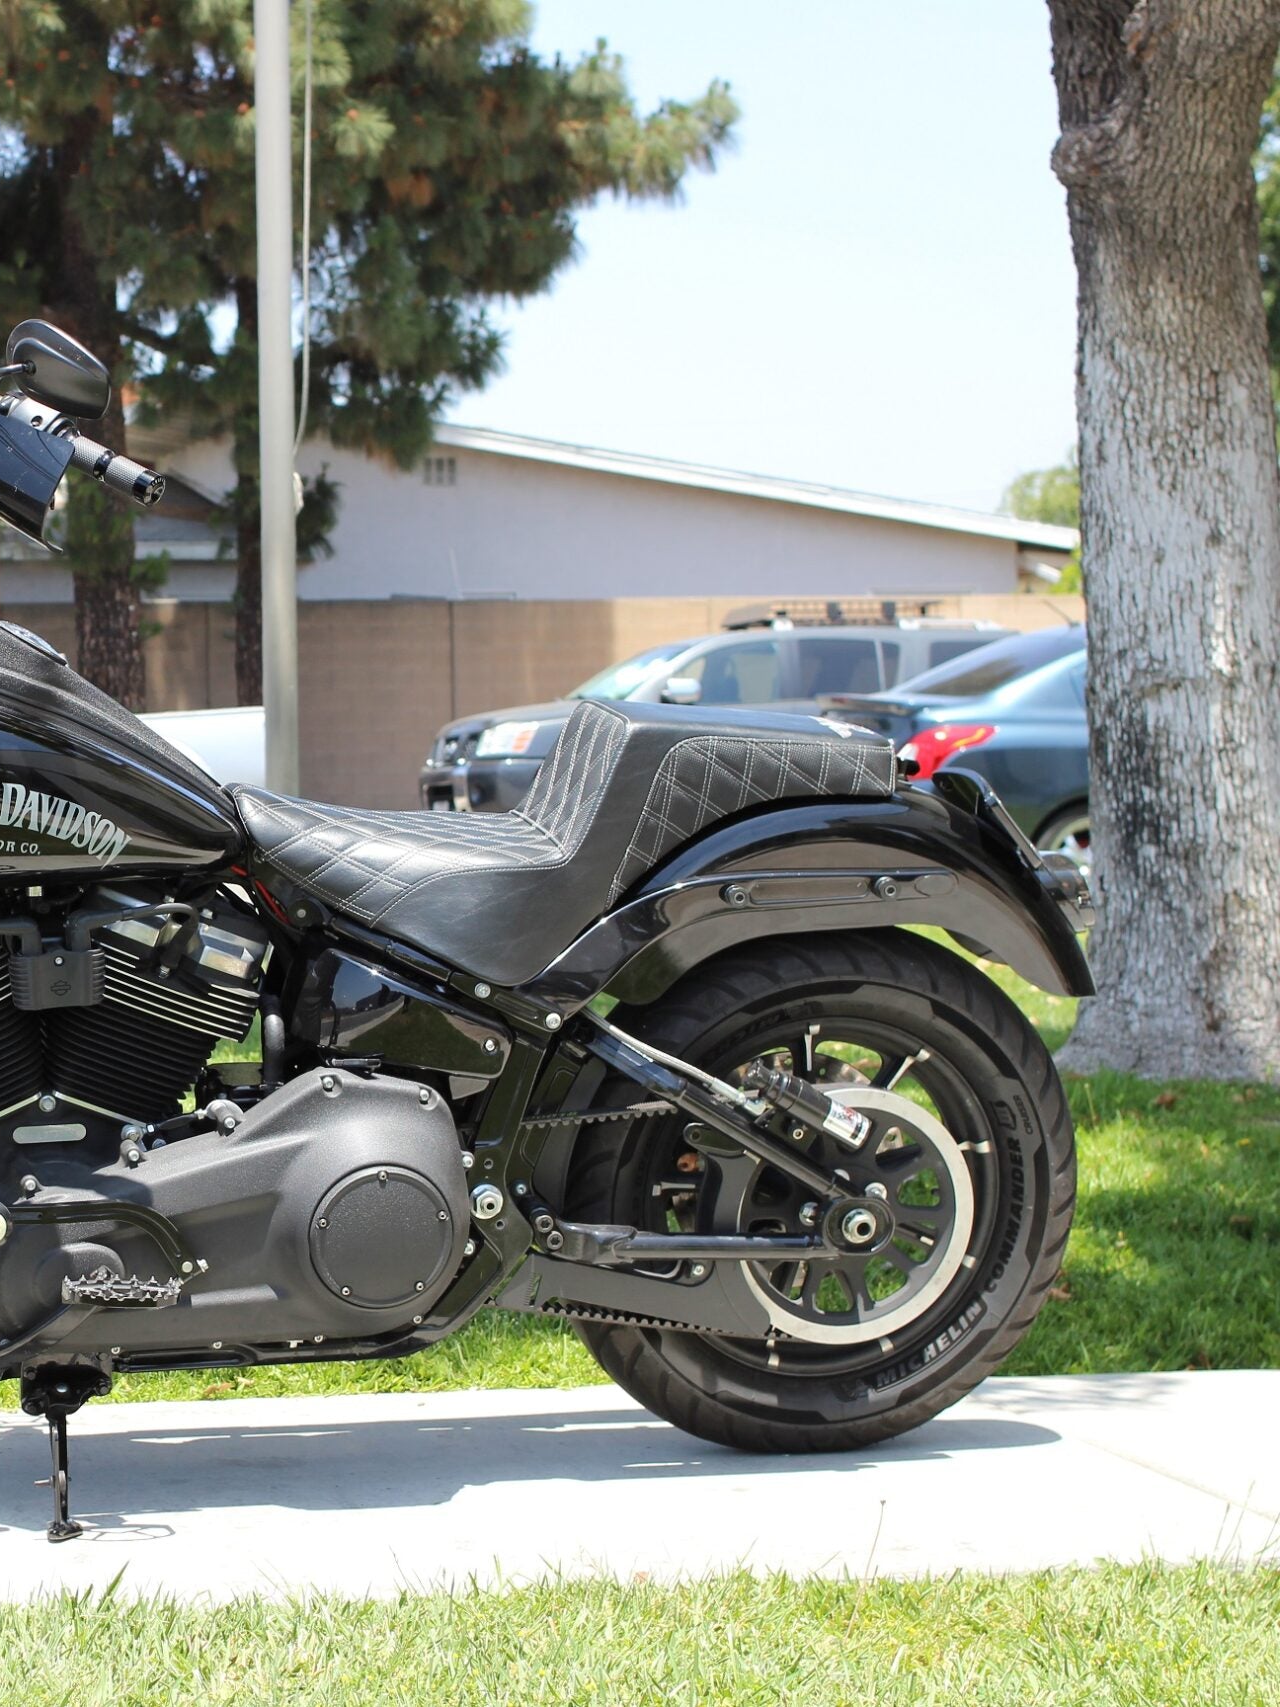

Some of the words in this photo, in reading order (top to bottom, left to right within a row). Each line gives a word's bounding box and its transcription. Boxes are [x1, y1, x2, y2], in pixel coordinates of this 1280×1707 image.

[20, 842, 41, 856] CO.
[984, 1136, 1025, 1294] COMMANDER
[876, 1300, 984, 1388] MICHELIN
